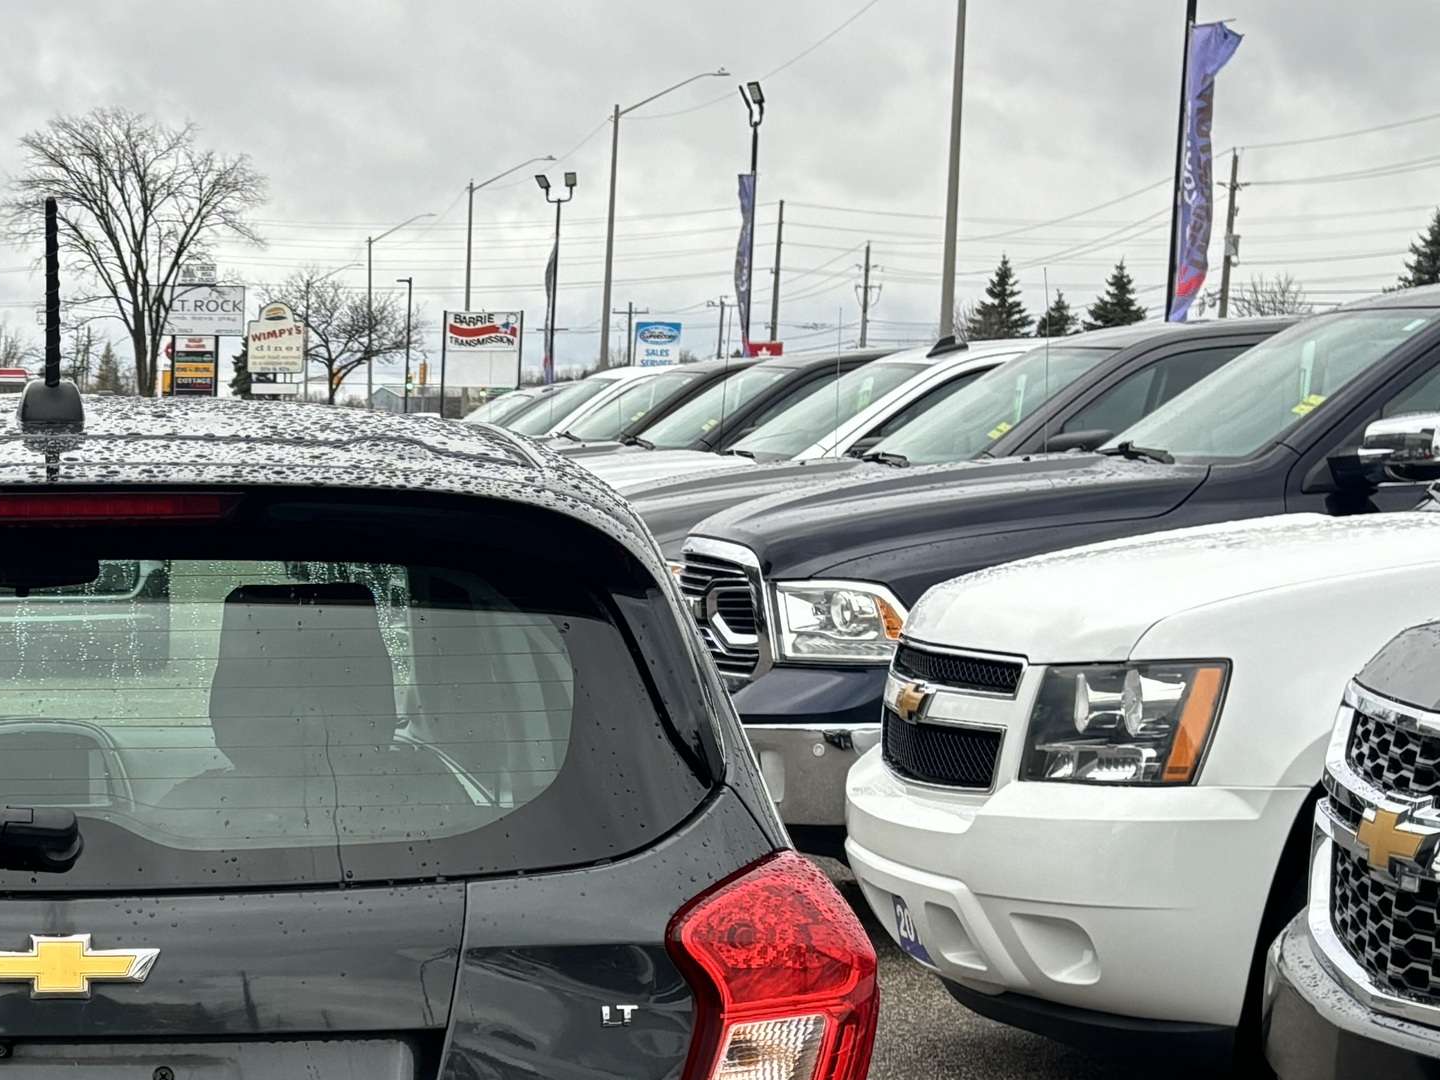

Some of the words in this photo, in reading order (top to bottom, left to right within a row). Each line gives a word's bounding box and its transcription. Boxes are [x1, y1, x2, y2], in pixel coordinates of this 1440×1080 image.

[453, 313, 495, 326] BARRIE
[251, 324, 302, 342] WIMPY'S
[449, 335, 515, 347] TRANSMISSION
[601, 1004, 640, 1026] LT
